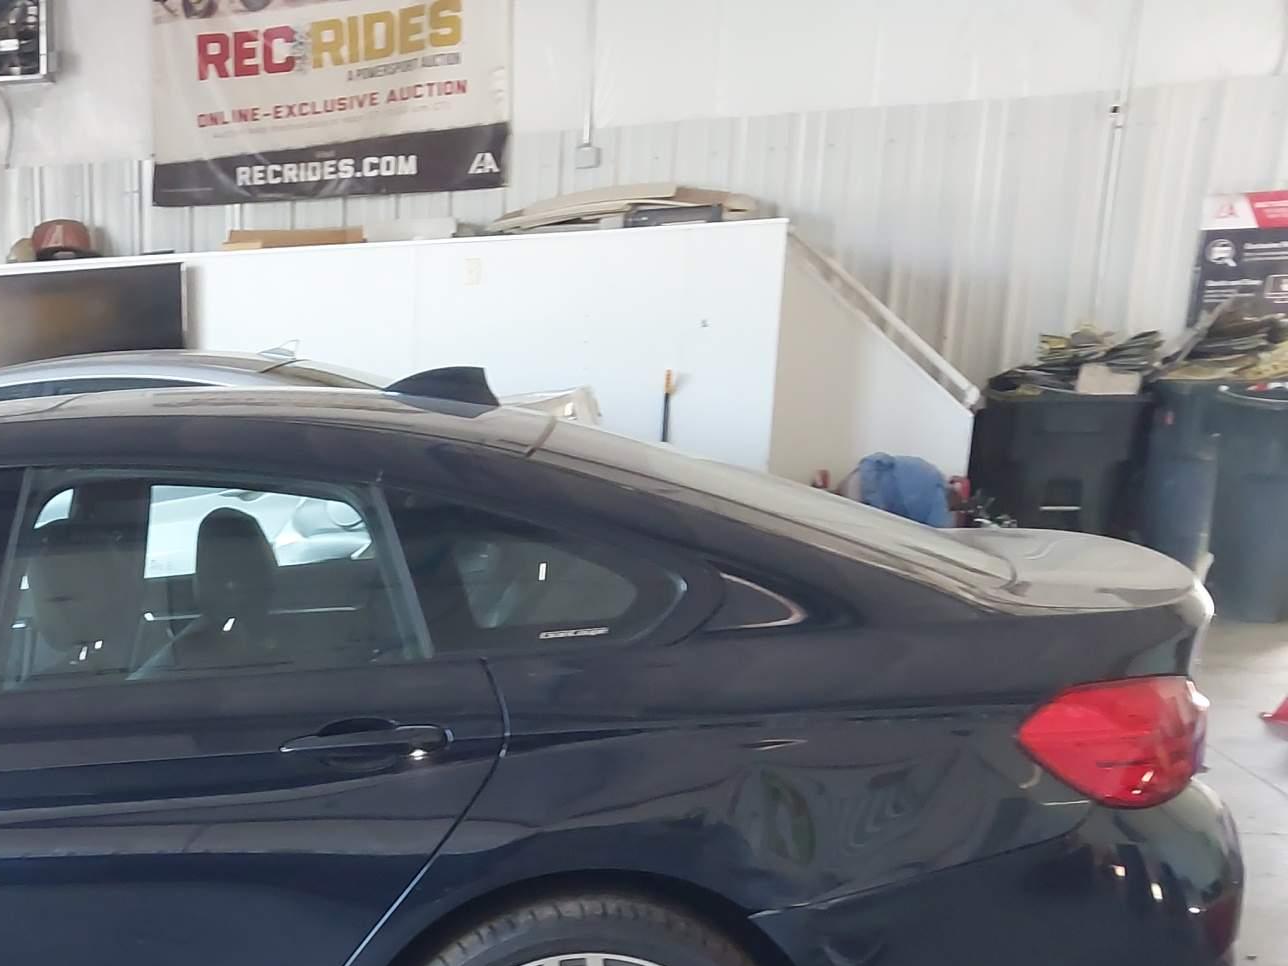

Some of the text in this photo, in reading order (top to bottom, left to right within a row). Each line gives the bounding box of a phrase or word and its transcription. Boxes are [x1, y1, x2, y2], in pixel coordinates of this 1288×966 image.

[197, 25, 296, 81] REC
[312, 0, 463, 69] RIDES
[197, 98, 379, 128] ONLINE-EXCLUSIVE
[386, 79, 468, 104] AUCTION
[236, 155, 417, 187] RECRIDES.COM
